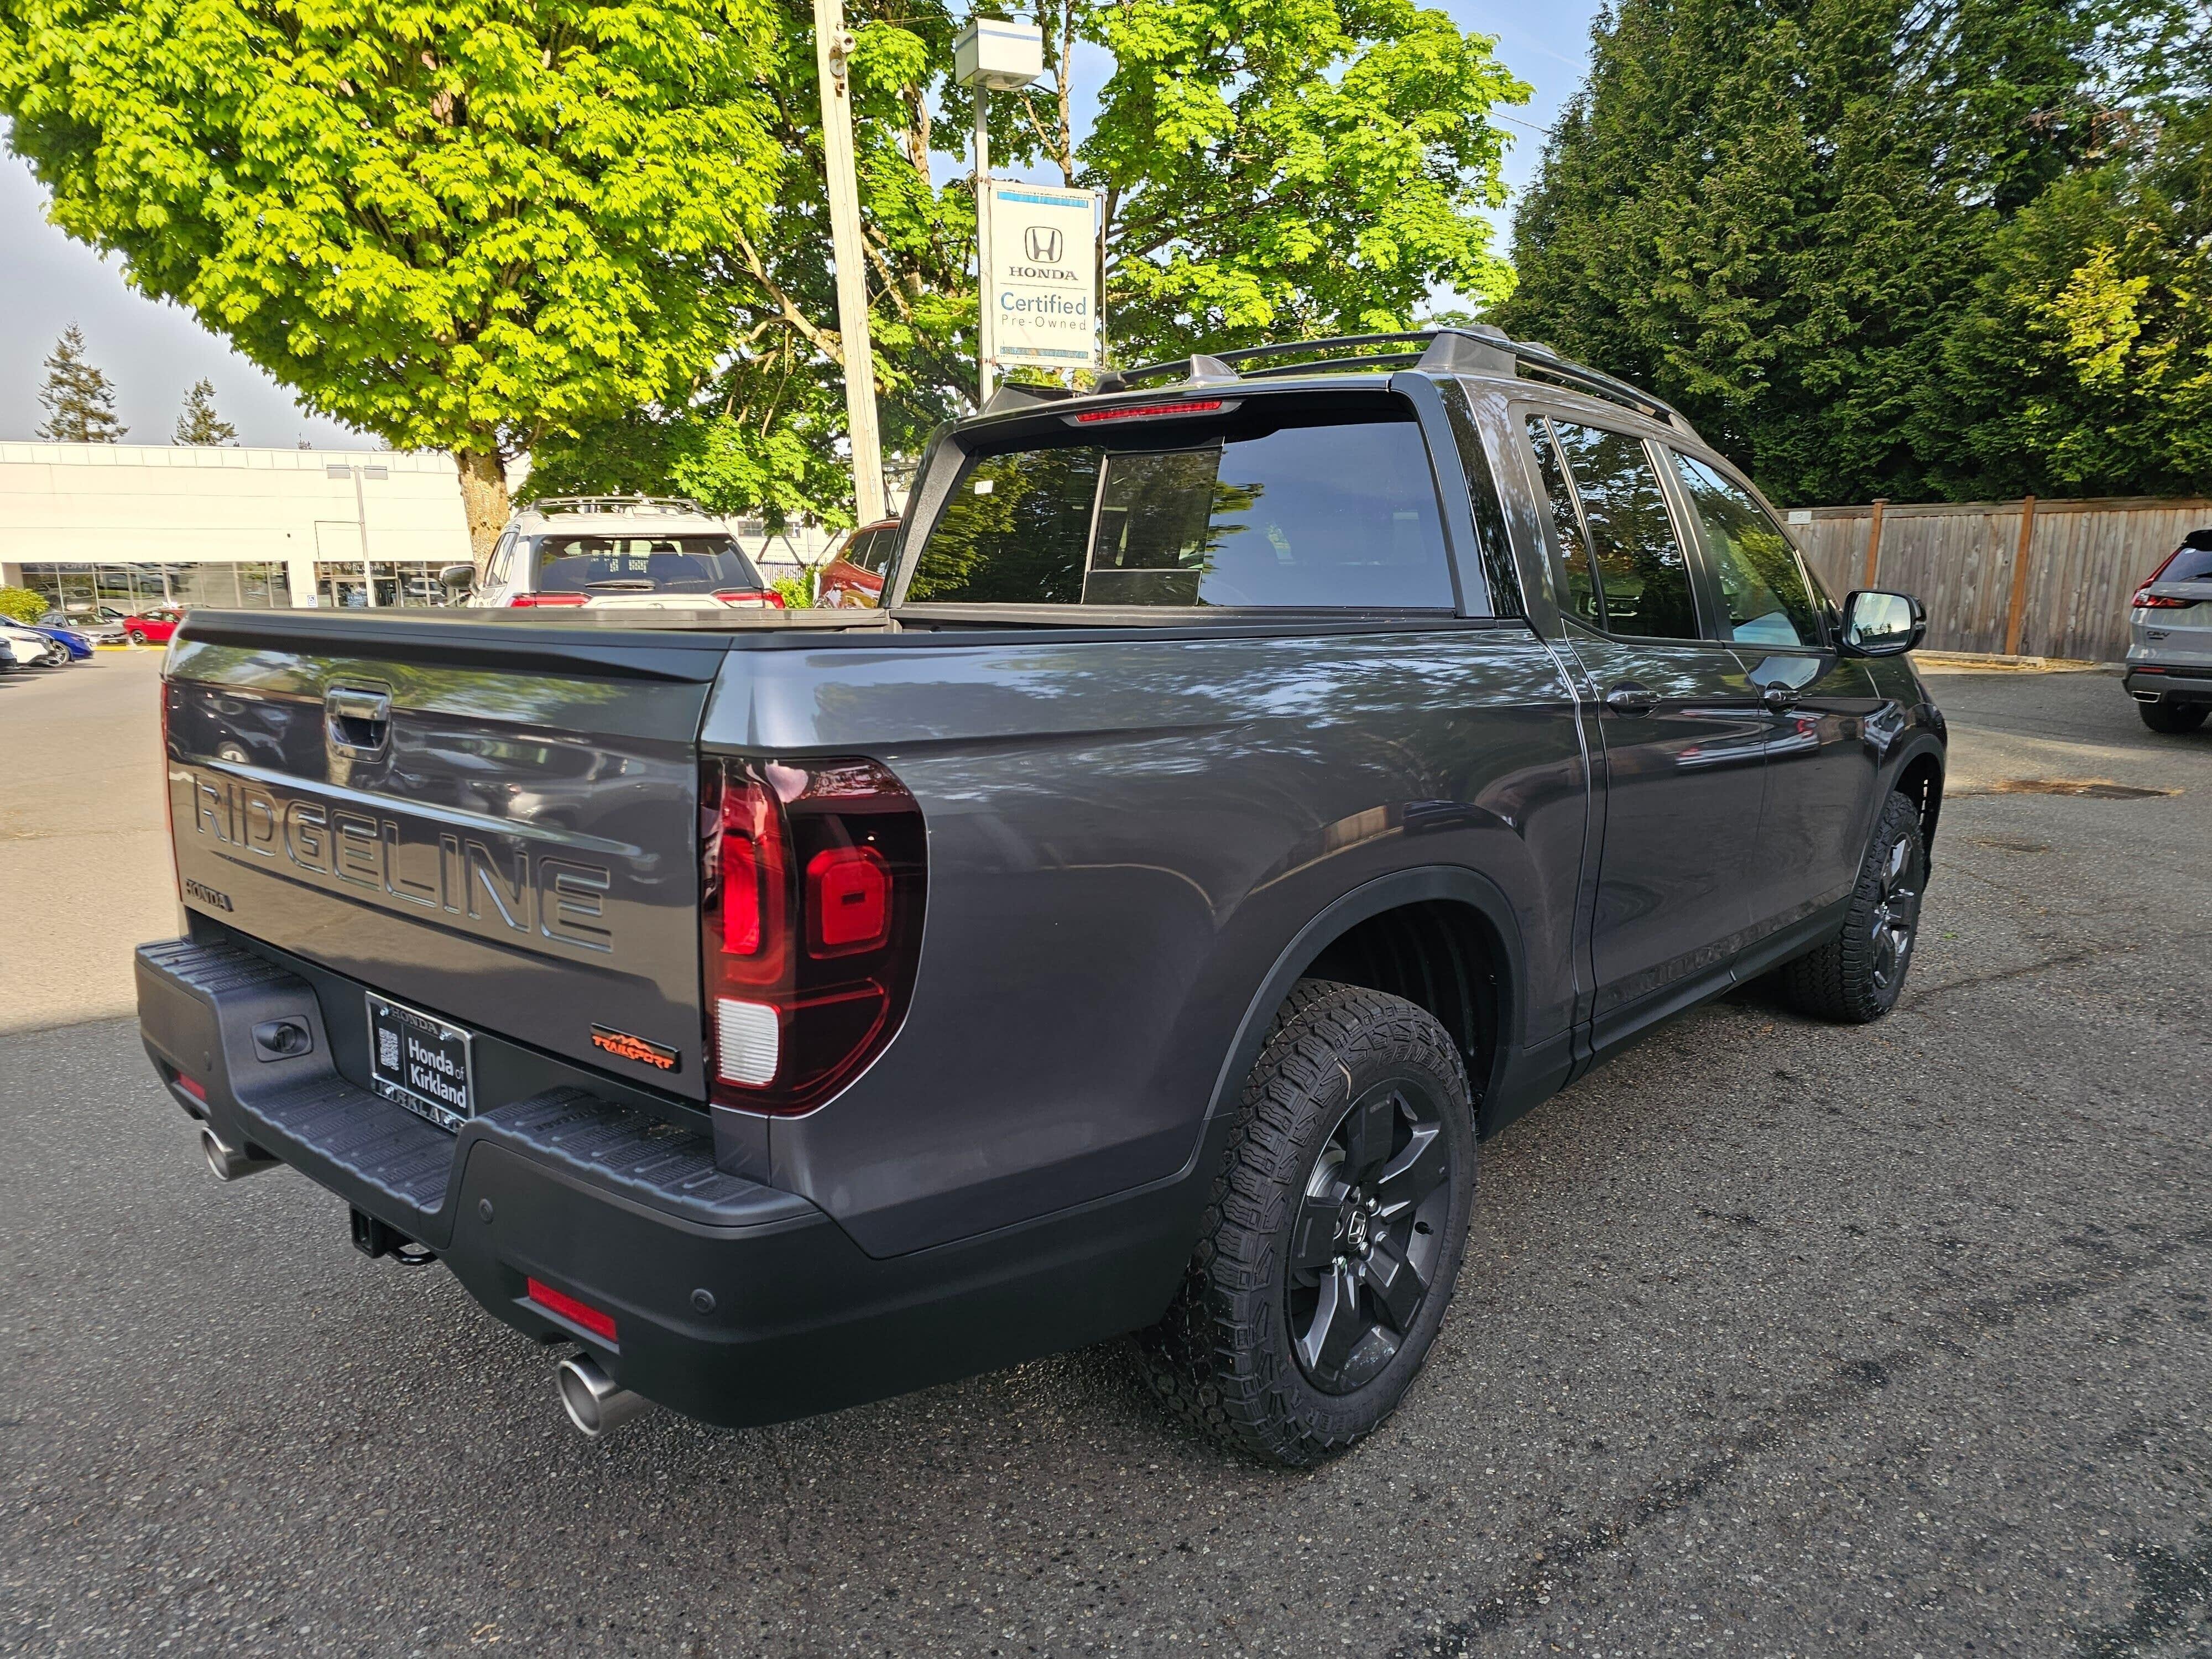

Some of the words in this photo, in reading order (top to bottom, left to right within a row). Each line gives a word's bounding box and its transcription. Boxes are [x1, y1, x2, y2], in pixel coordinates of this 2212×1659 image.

[1009, 267, 1078, 281] HONDA
[1001, 291, 1086, 315] Certified
[1002, 314, 1086, 330] Pre-Owned
[192, 773, 615, 954] RIDGELINE
[185, 878, 234, 912] HONDA
[392, 1006, 438, 1035] HONDA
[408, 1036, 454, 1077] Honda
[455, 1066, 465, 1081] of
[1375, 1044, 1461, 1107] GENERAL
[410, 1063, 467, 1109] Kirkland
